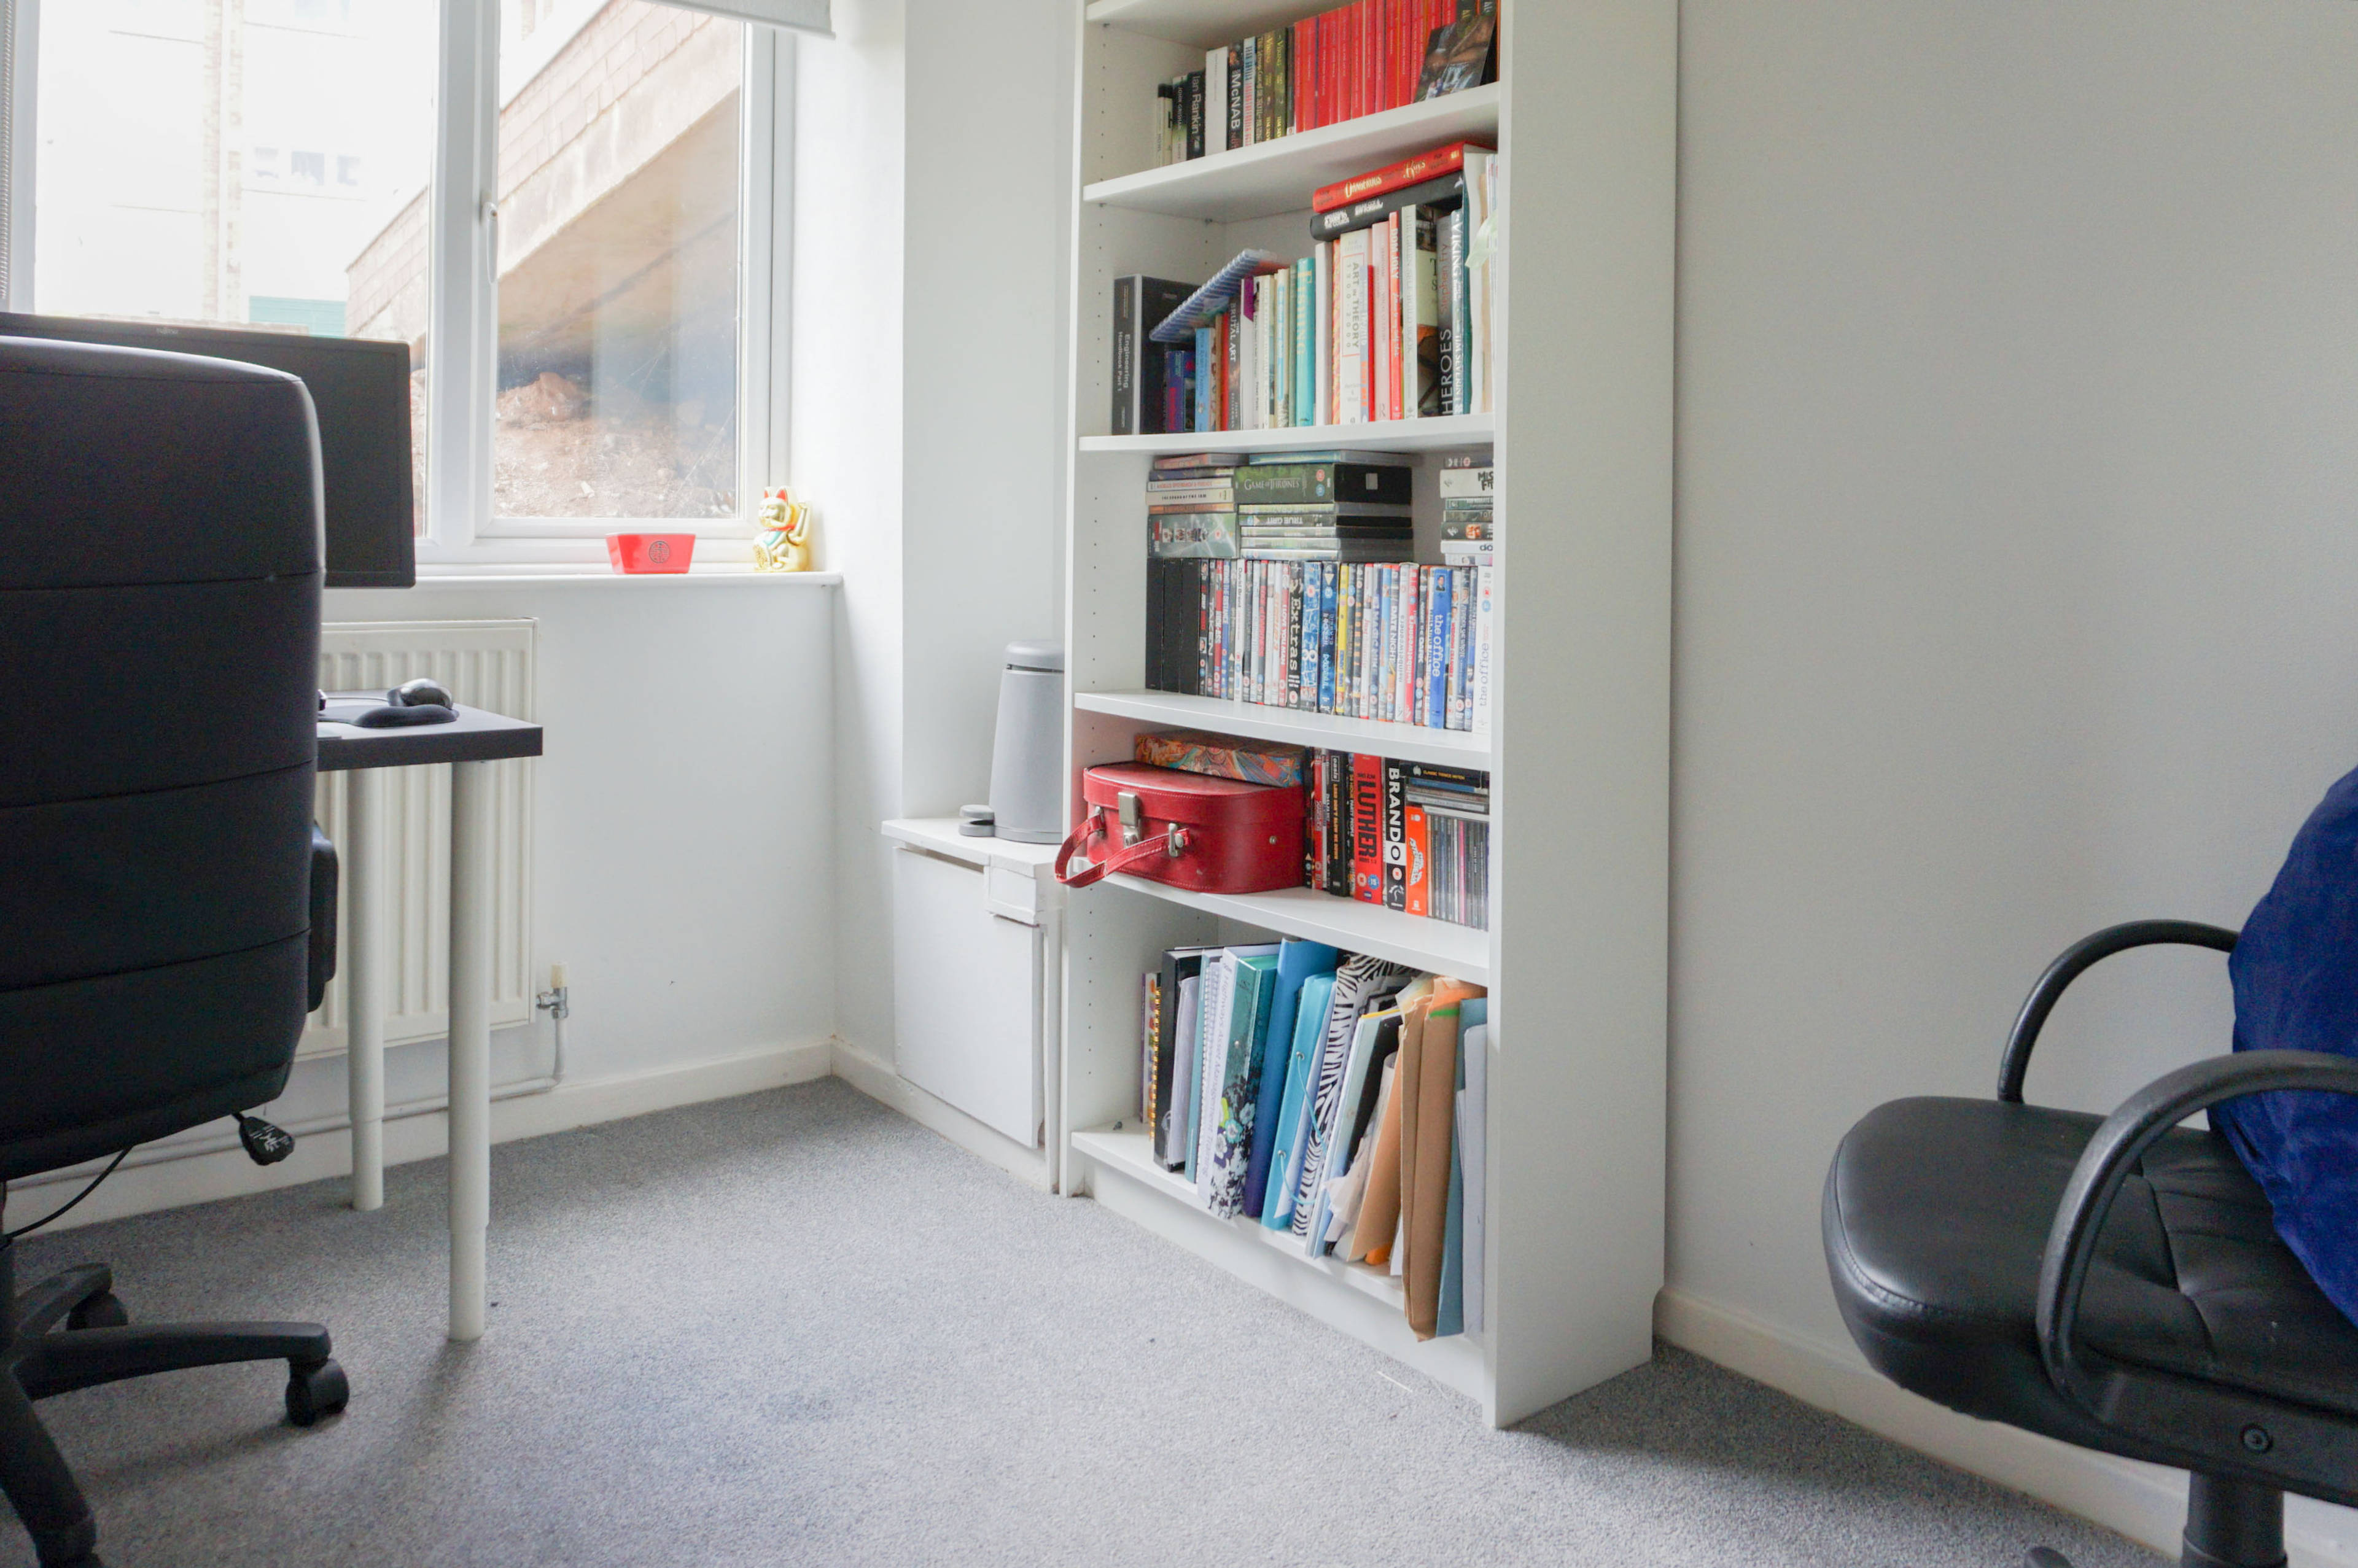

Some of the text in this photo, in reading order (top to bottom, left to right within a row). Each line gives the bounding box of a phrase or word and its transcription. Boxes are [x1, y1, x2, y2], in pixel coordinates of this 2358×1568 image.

[1191, 76, 1201, 134] Ian Rankin
[1231, 74, 1241, 129] McNAB
[1439, 244, 1451, 315] Stephen Fry
[1452, 222, 1463, 276] VIKING
[1296, 269, 1312, 355] FISHING
[1439, 329, 1453, 415] HEROES
[1244, 478, 1264, 491] GAME
[1269, 477, 1301, 490] THRONES
[1481, 479, 1493, 491] FIT
[1290, 597, 1301, 670] Extras
[1433, 614, 1444, 677] the office
[1478, 642, 1489, 707] the office
[1357, 780, 1377, 858] LUTHER
[1202, 975, 1230, 1178] Highways Asset Management Training
